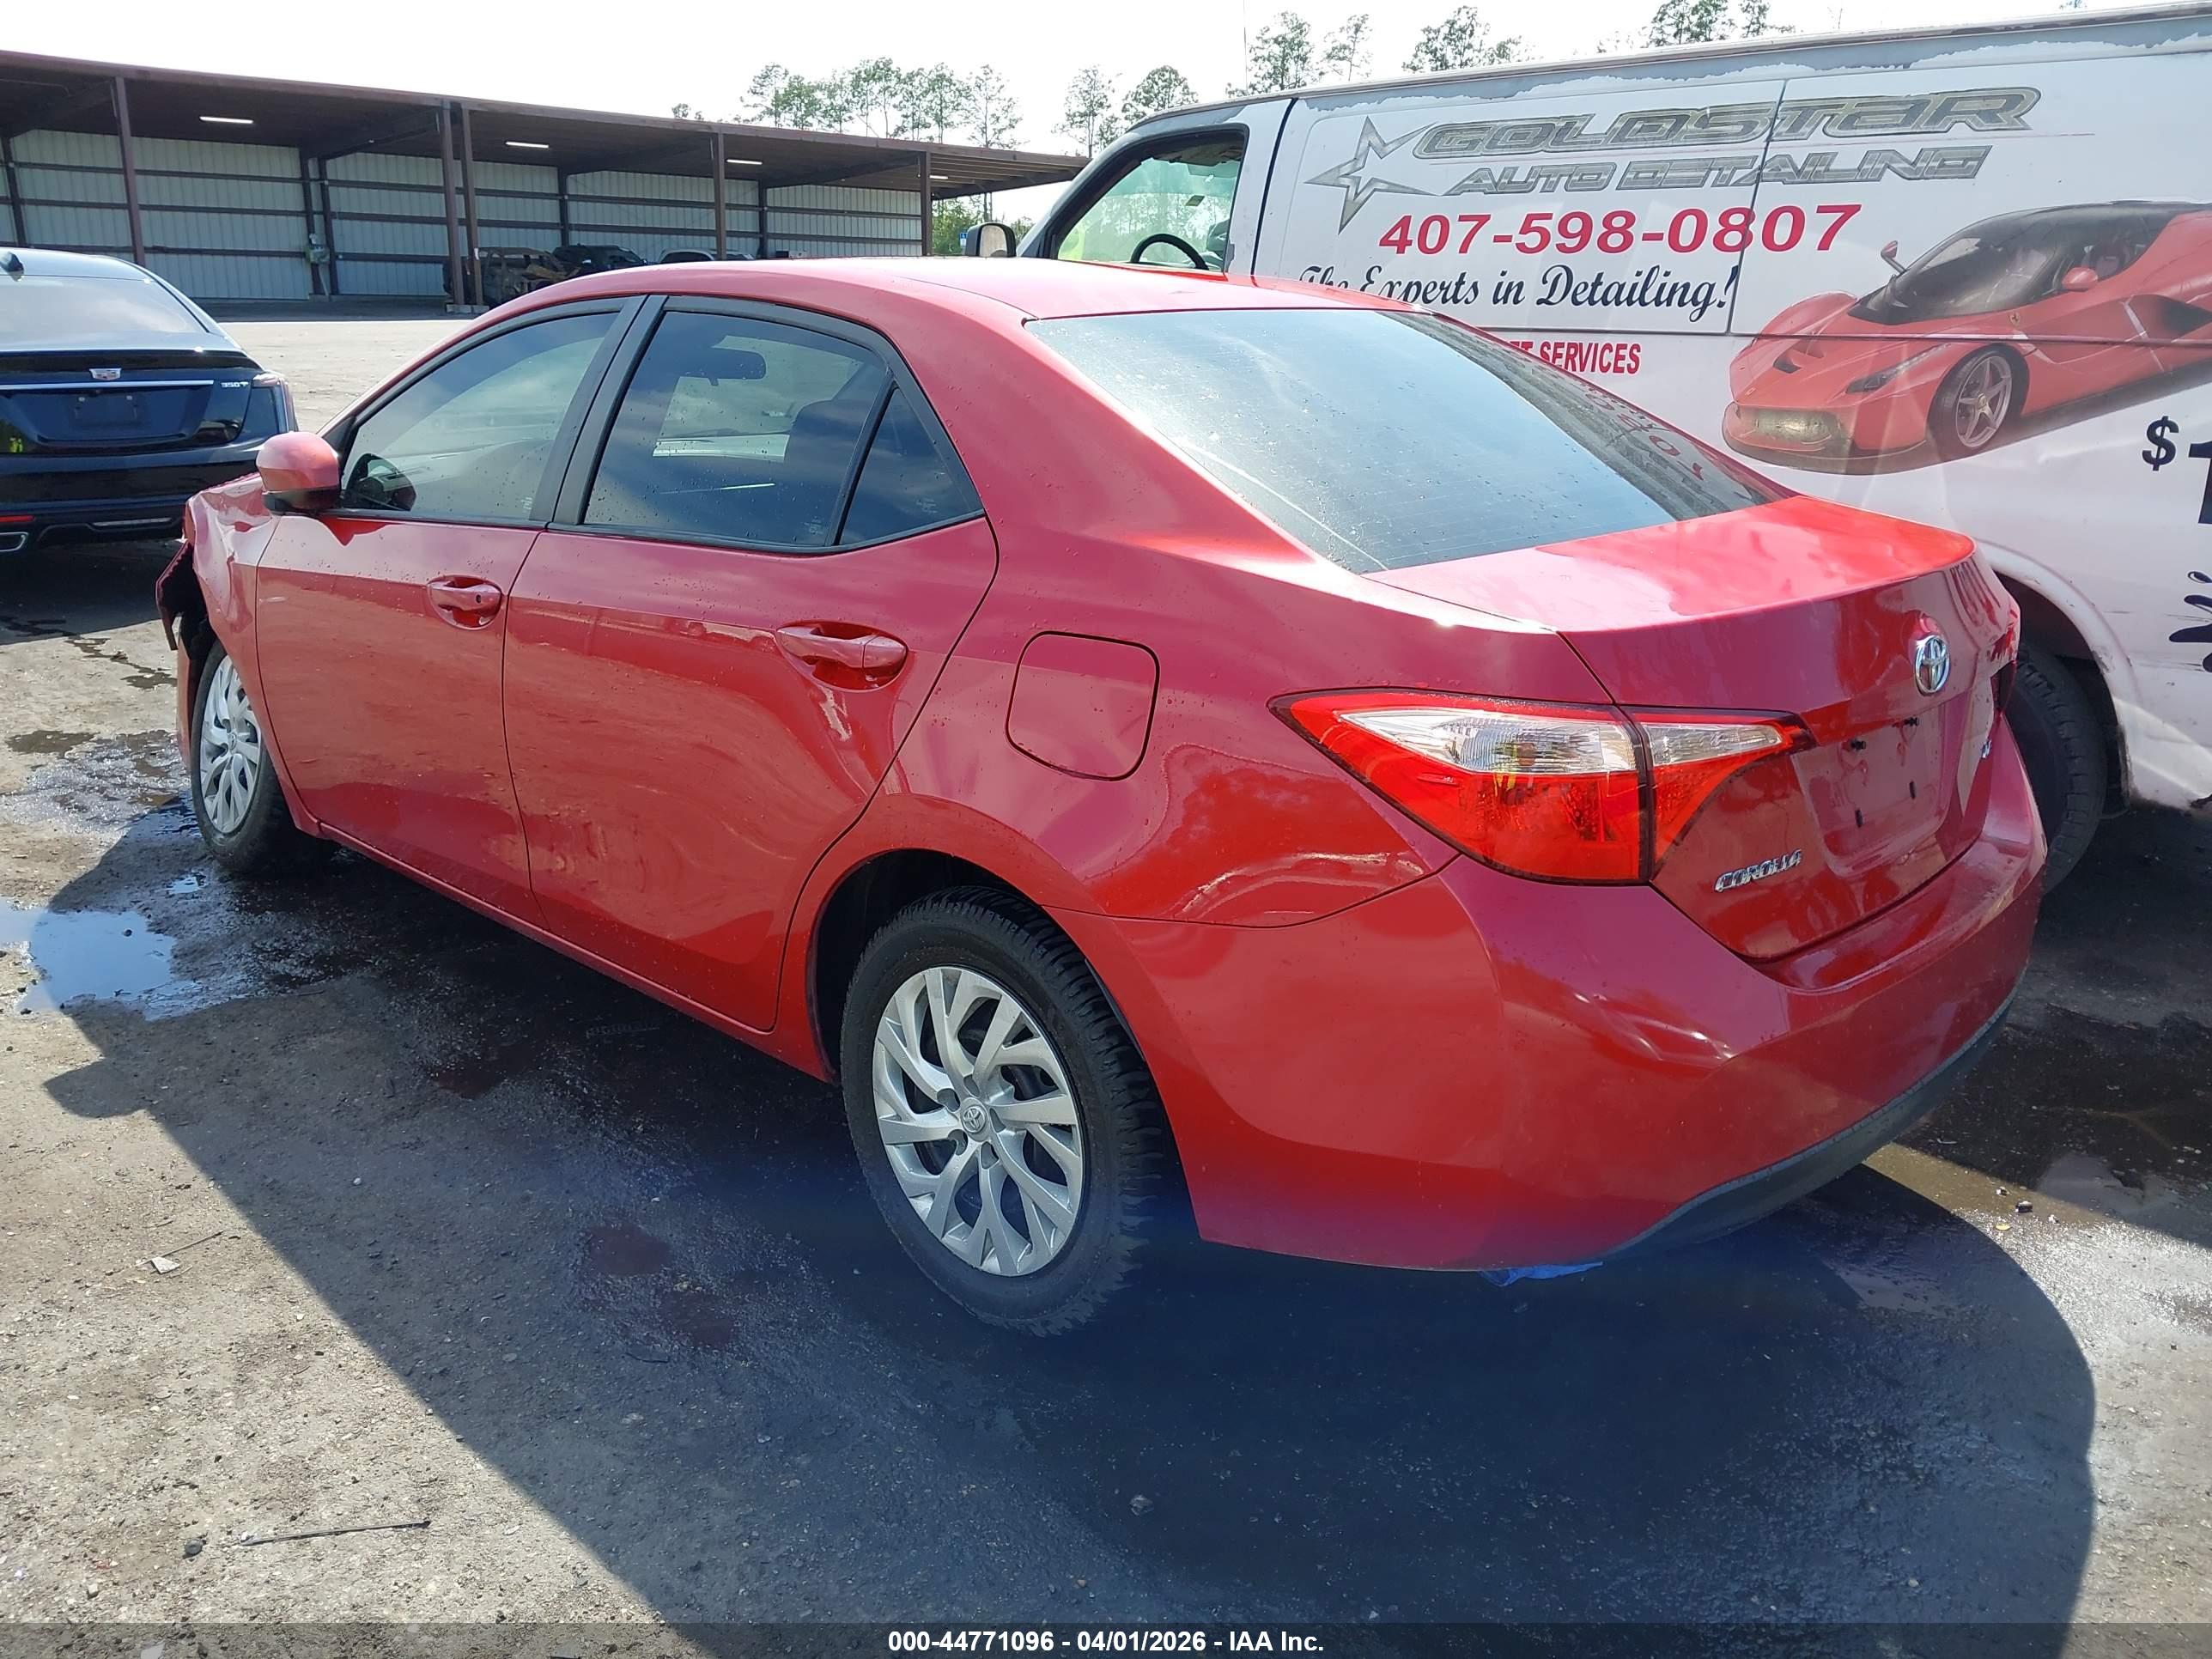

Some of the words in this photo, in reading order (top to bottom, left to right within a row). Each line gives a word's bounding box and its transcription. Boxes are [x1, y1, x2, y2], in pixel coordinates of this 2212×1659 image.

[1413, 87, 2041, 159] GOLDSTAR
[1439, 162, 1617, 197] AUTO
[1615, 145, 1993, 191] DETAILING
[1378, 204, 1863, 255] 407-598-0807
[1359, 264, 1480, 305] Experts
[1492, 270, 1526, 306] in
[1535, 264, 1740, 323] Detailing!
[1540, 340, 1642, 374] SERVICES
[1715, 848, 1802, 892] COROLLA
